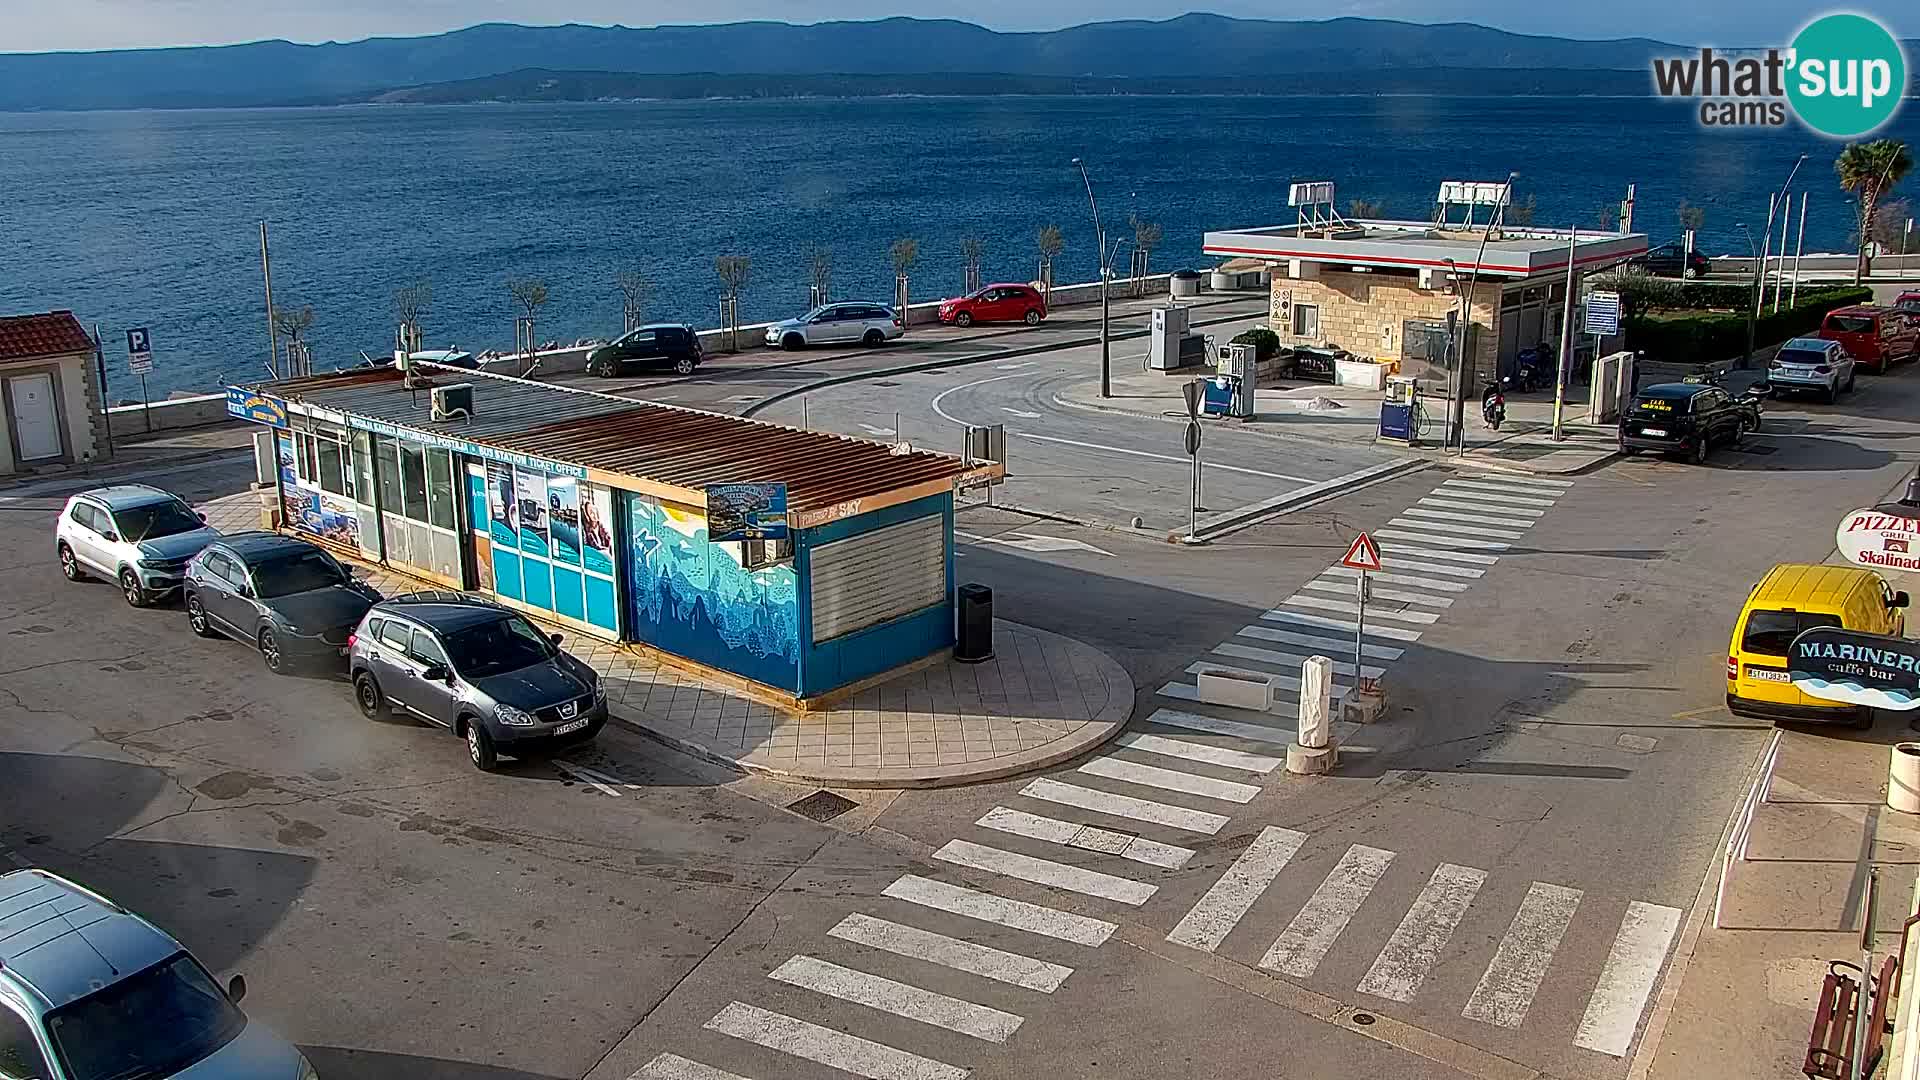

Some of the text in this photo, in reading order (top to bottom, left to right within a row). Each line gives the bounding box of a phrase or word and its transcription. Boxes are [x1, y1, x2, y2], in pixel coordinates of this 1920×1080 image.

[131, 331, 144, 350] P
[437, 437, 468, 452] POSTAJA
[478, 447, 494, 458] BUS
[494, 450, 527, 465] STATION
[529, 457, 555, 471] TICKET
[556, 464, 583, 477] OFFICE
[1847, 516, 1920, 533] PIZZE
[1828, 662, 1896, 681] caffe bar
